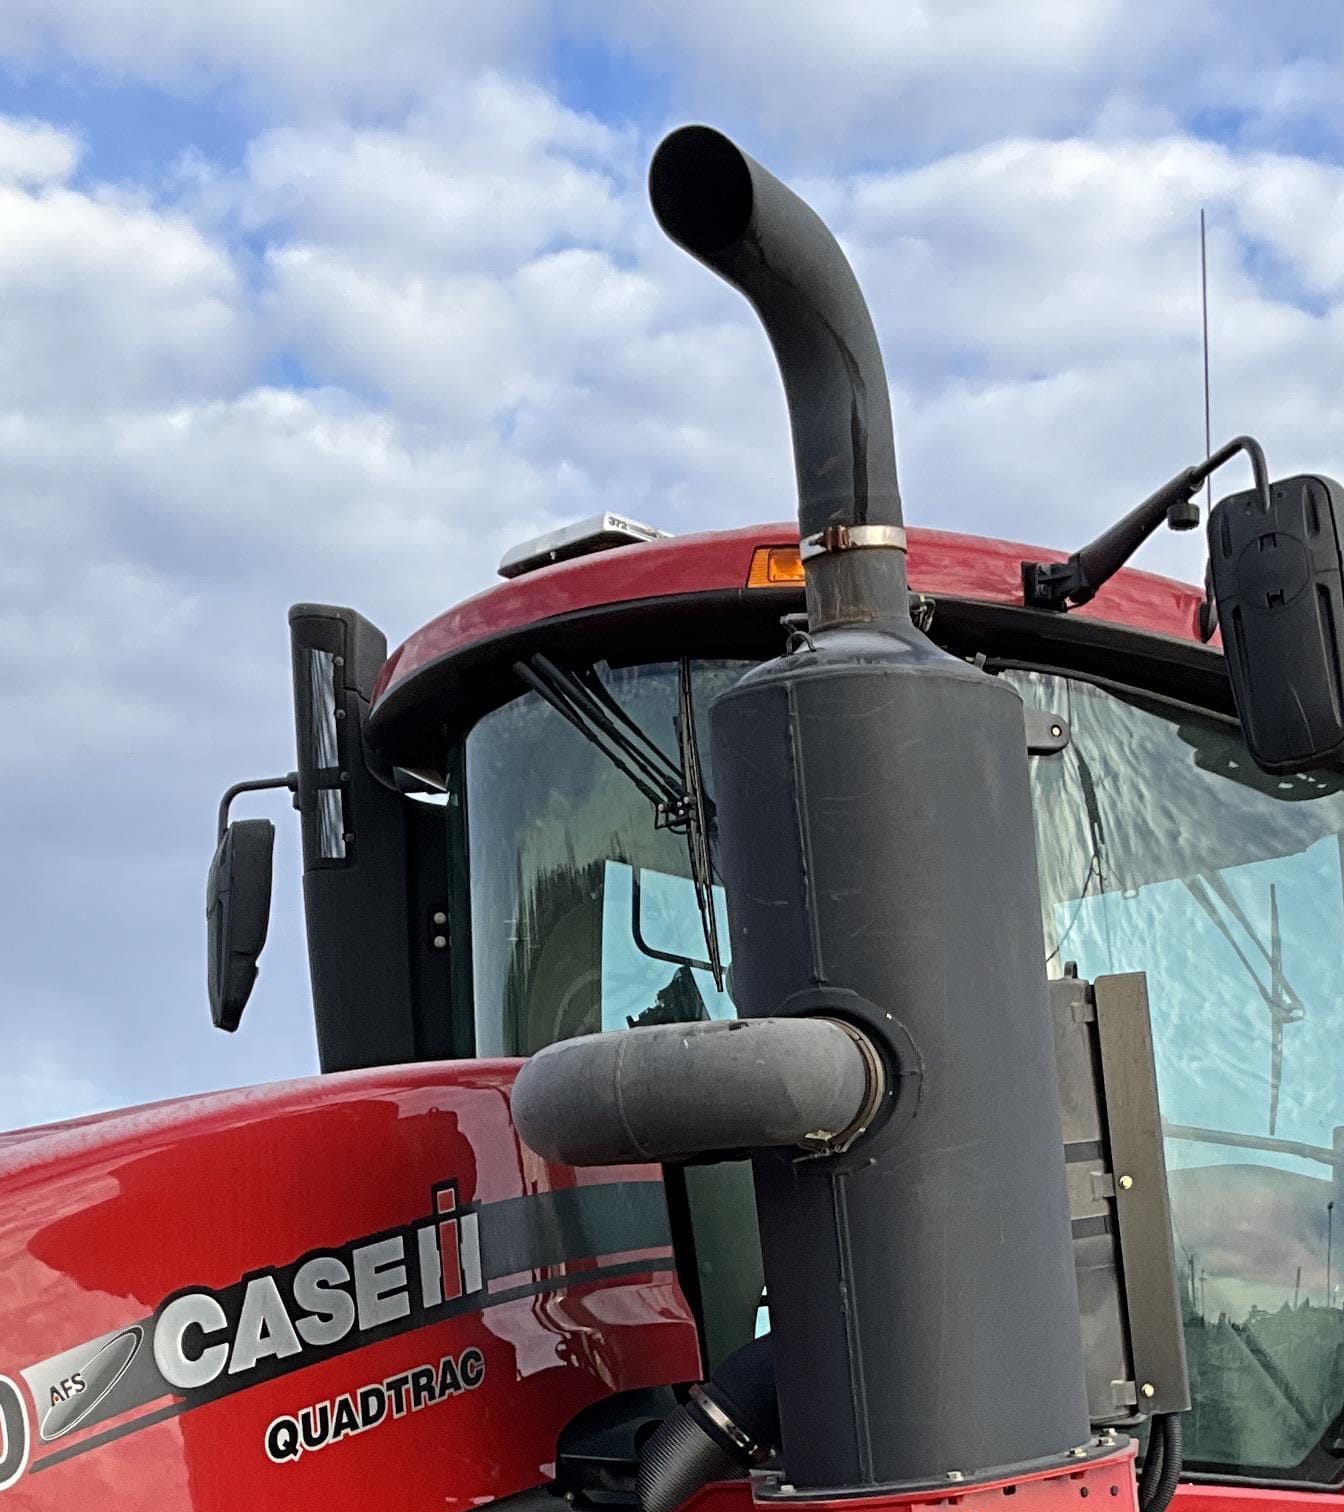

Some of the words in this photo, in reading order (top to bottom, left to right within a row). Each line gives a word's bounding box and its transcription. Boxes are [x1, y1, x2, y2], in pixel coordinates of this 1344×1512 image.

[154, 1235, 410, 1389] CASE
[50, 1372, 86, 1407] AFS
[265, 1346, 485, 1464] QUADTRAC
